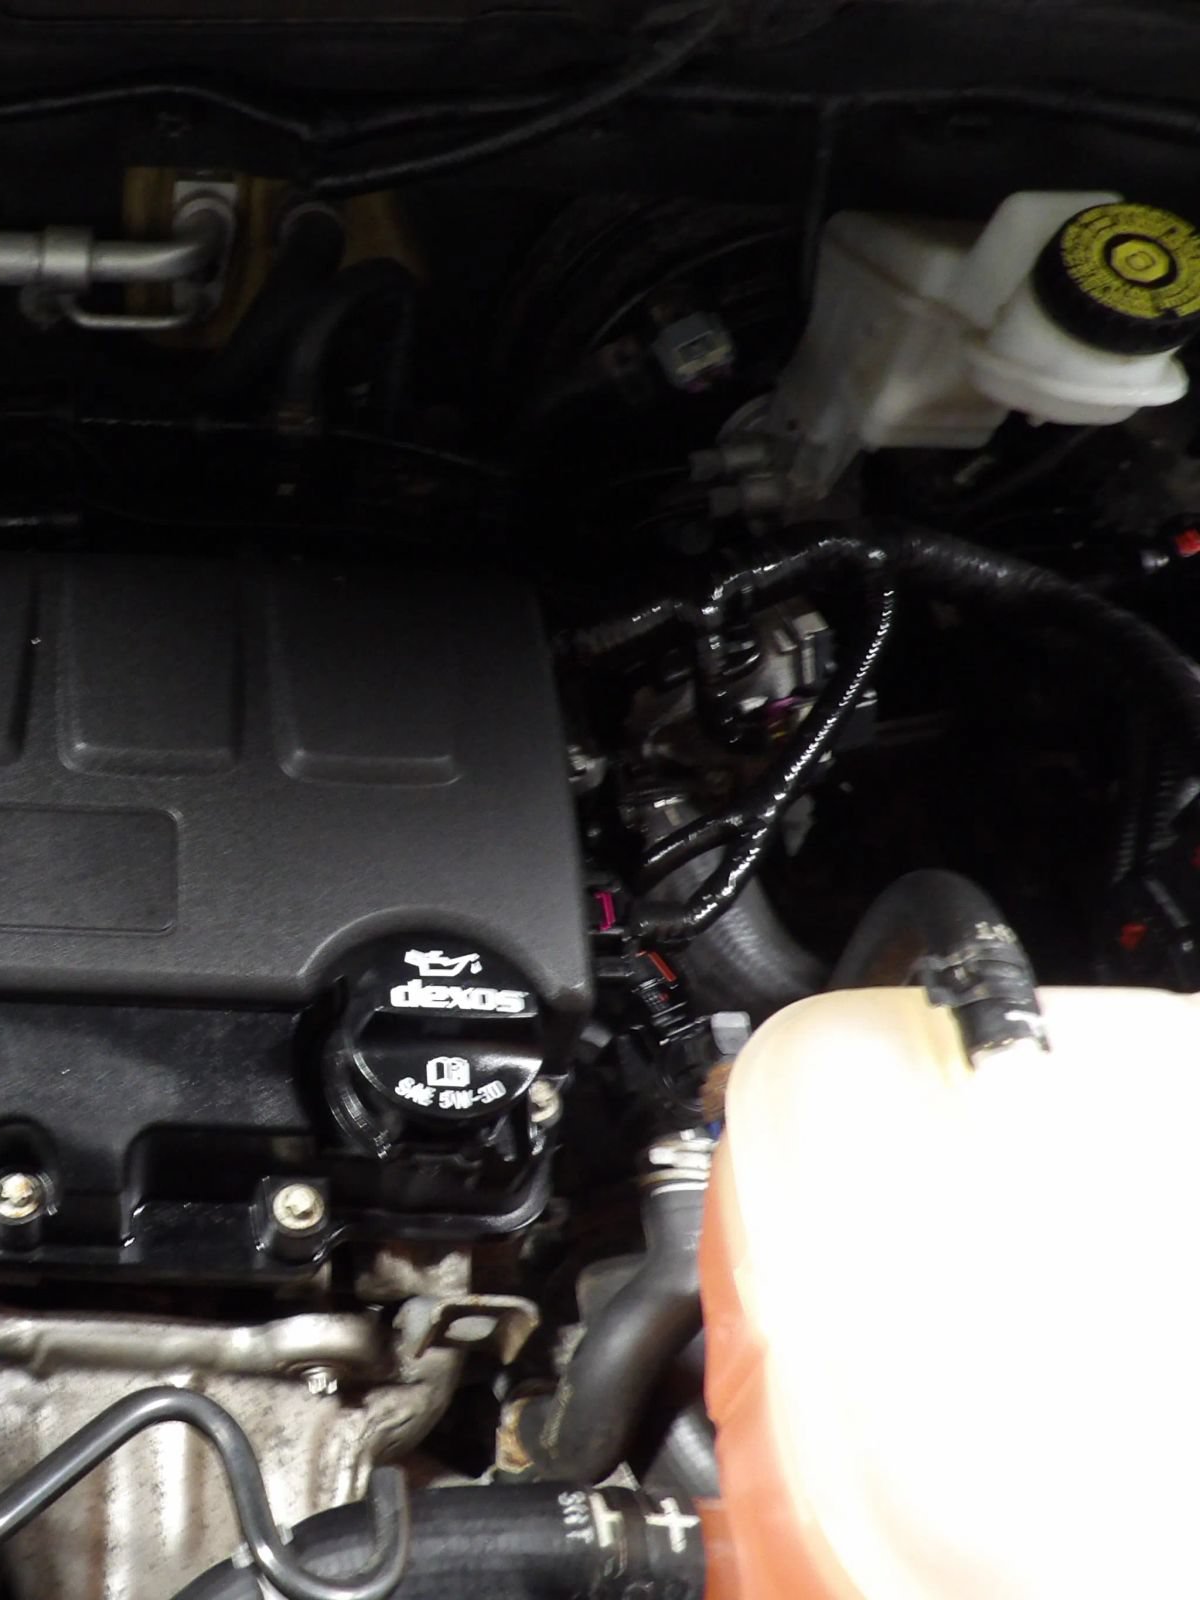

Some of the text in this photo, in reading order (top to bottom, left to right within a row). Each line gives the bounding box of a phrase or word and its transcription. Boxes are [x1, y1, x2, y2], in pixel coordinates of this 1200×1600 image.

[390, 979, 529, 1013] dexos
[395, 1077, 506, 1109] SAE 5W-30
